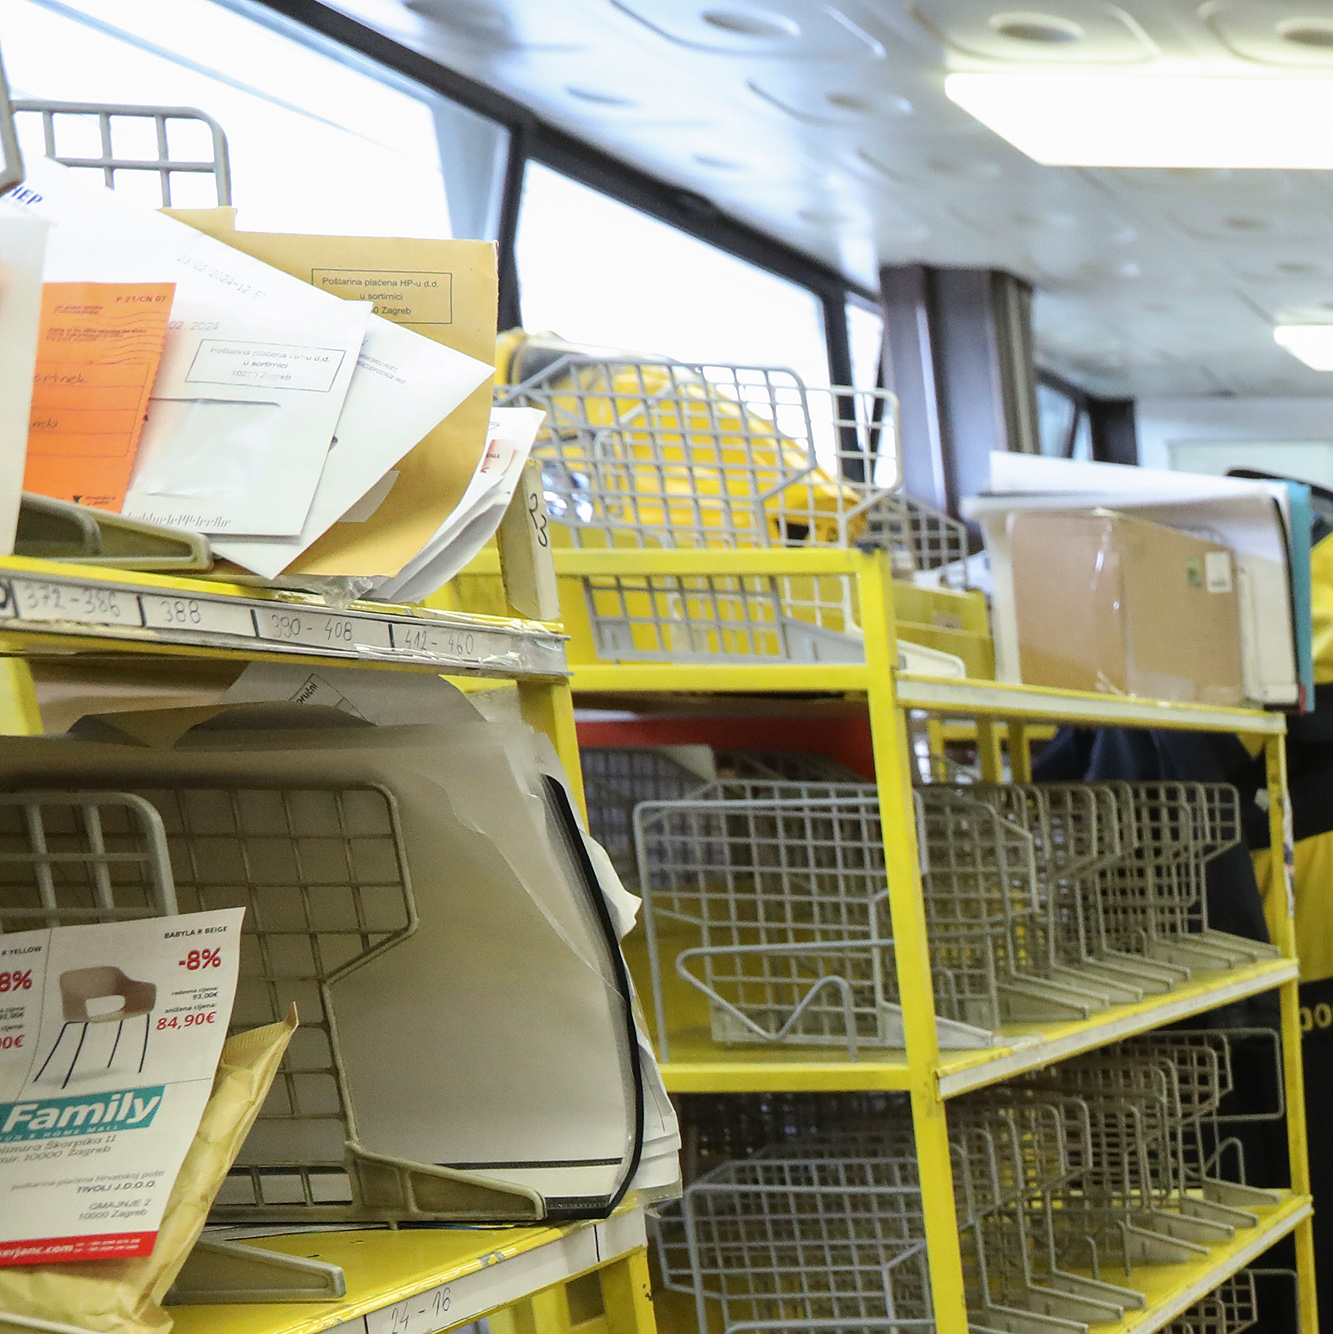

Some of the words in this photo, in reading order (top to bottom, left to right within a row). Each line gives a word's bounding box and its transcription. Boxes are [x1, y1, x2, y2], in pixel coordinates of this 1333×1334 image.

[322, 276, 361, 286] Poštarina
[364, 278, 398, 287] plaćena
[400, 280, 421, 288] HP-u
[382, 306, 411, 316] Zagreb
[27, 583, 65, 609] 372
[162, 601, 200, 624] 388
[325, 619, 353, 642] 408
[448, 633, 474, 654] 460
[205, 926, 228, 934] BEIGE
[9, 946, 43, 955] YELLOW
[178, 948, 222, 971] -8%
[157, 1011, 218, 1030] 84,90€
[2, 1092, 162, 1133] Family
[48, 1136, 103, 1153] Škorpika
[67, 1144, 111, 1157] Zagreb
[77, 1184, 112, 1194] TIVOLI
[110, 1209, 148, 1219] Zagreb
